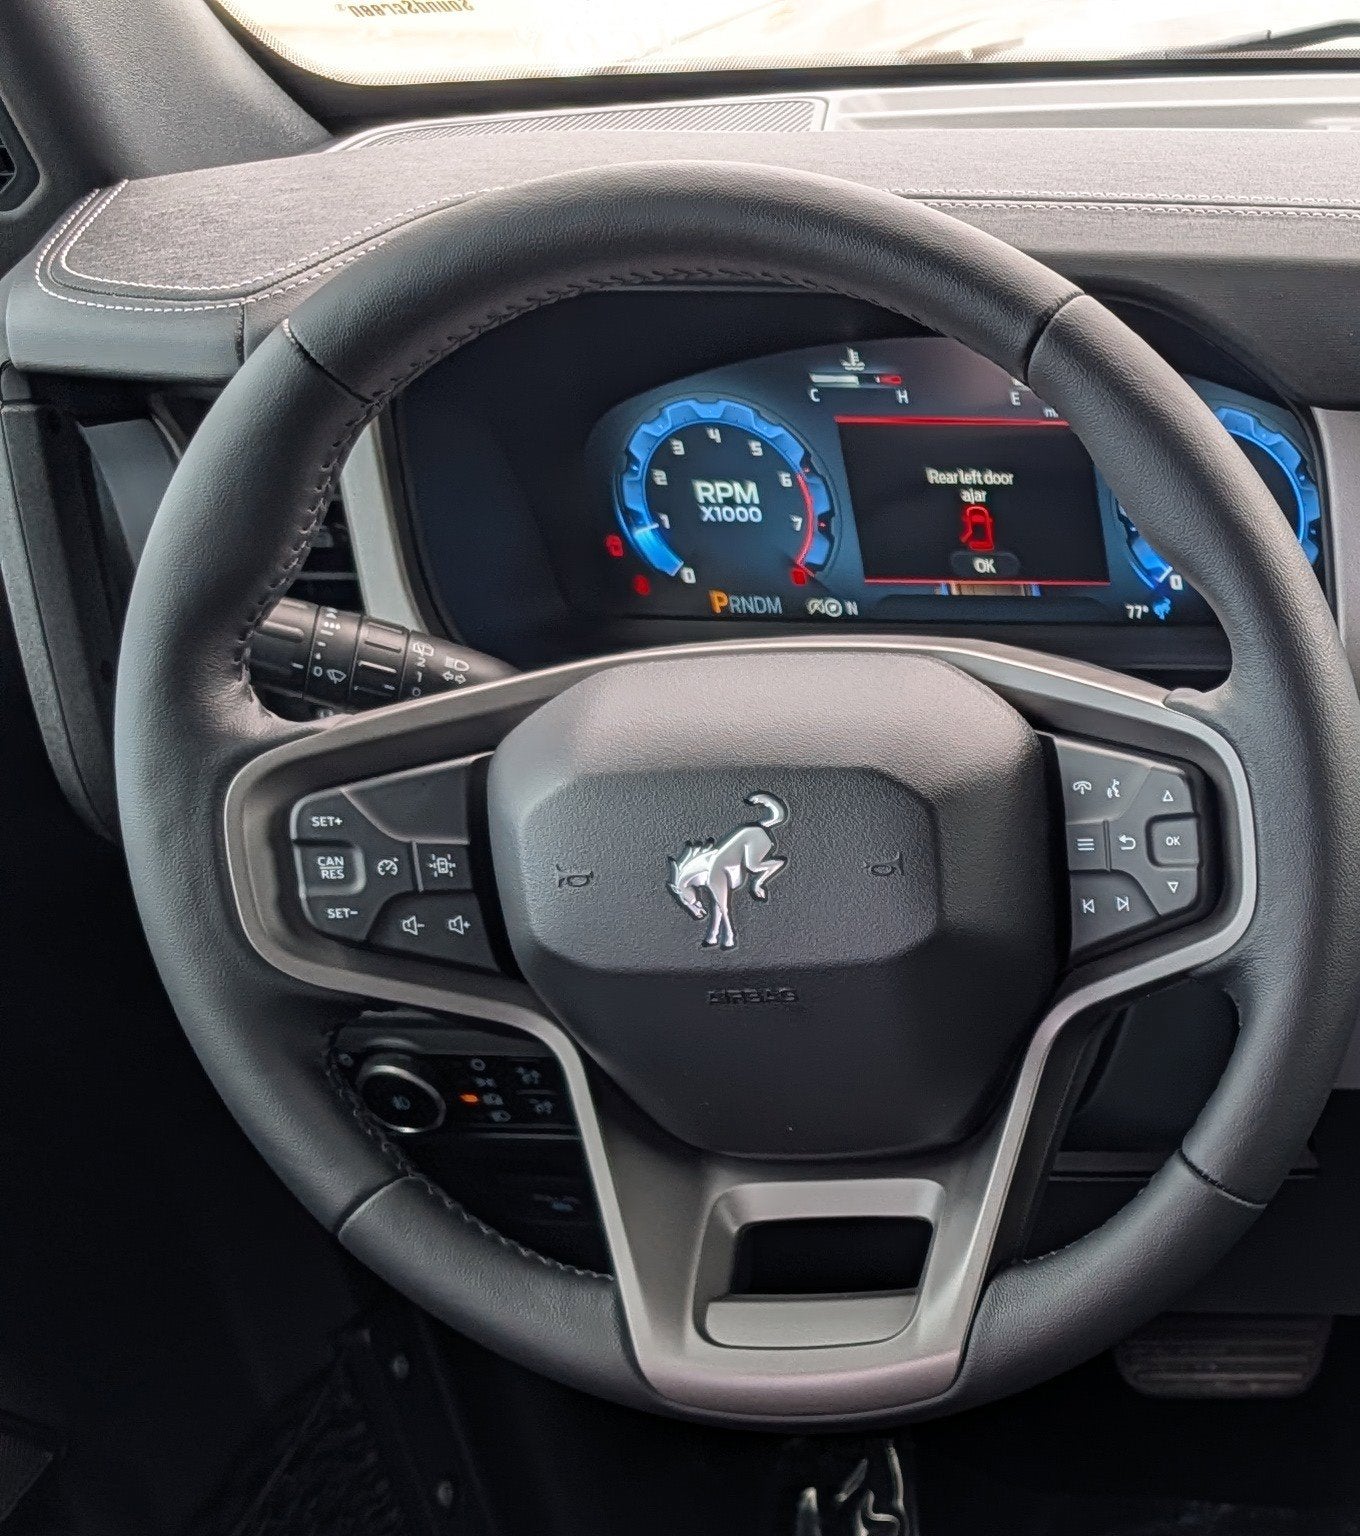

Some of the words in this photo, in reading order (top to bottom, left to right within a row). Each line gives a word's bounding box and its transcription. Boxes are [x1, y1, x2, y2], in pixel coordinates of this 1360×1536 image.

[808, 388, 820, 402] C
[896, 389, 909, 403] H
[1010, 392, 1021, 407] E
[706, 428, 722, 443] 4
[669, 438, 685, 455] 3
[748, 439, 764, 457] 5
[652, 469, 668, 486] 2
[778, 471, 792, 487] 6
[925, 467, 958, 484] Rear
[958, 468, 984, 485] left
[984, 470, 1014, 485] door
[692, 479, 760, 504] RPM
[960, 488, 987, 503] ajar
[659, 513, 671, 529] 1
[700, 506, 763, 523] X1000
[790, 515, 803, 531] 7
[973, 558, 996, 574] OK
[680, 567, 696, 584] 0
[1170, 575, 1183, 590] 0
[844, 601, 858, 615] N
[311, 816, 343, 827] SET+
[1165, 836, 1180, 846] OK
[317, 856, 344, 866] CAN
[321, 869, 345, 879] RES
[327, 907, 358, 919] SET-
